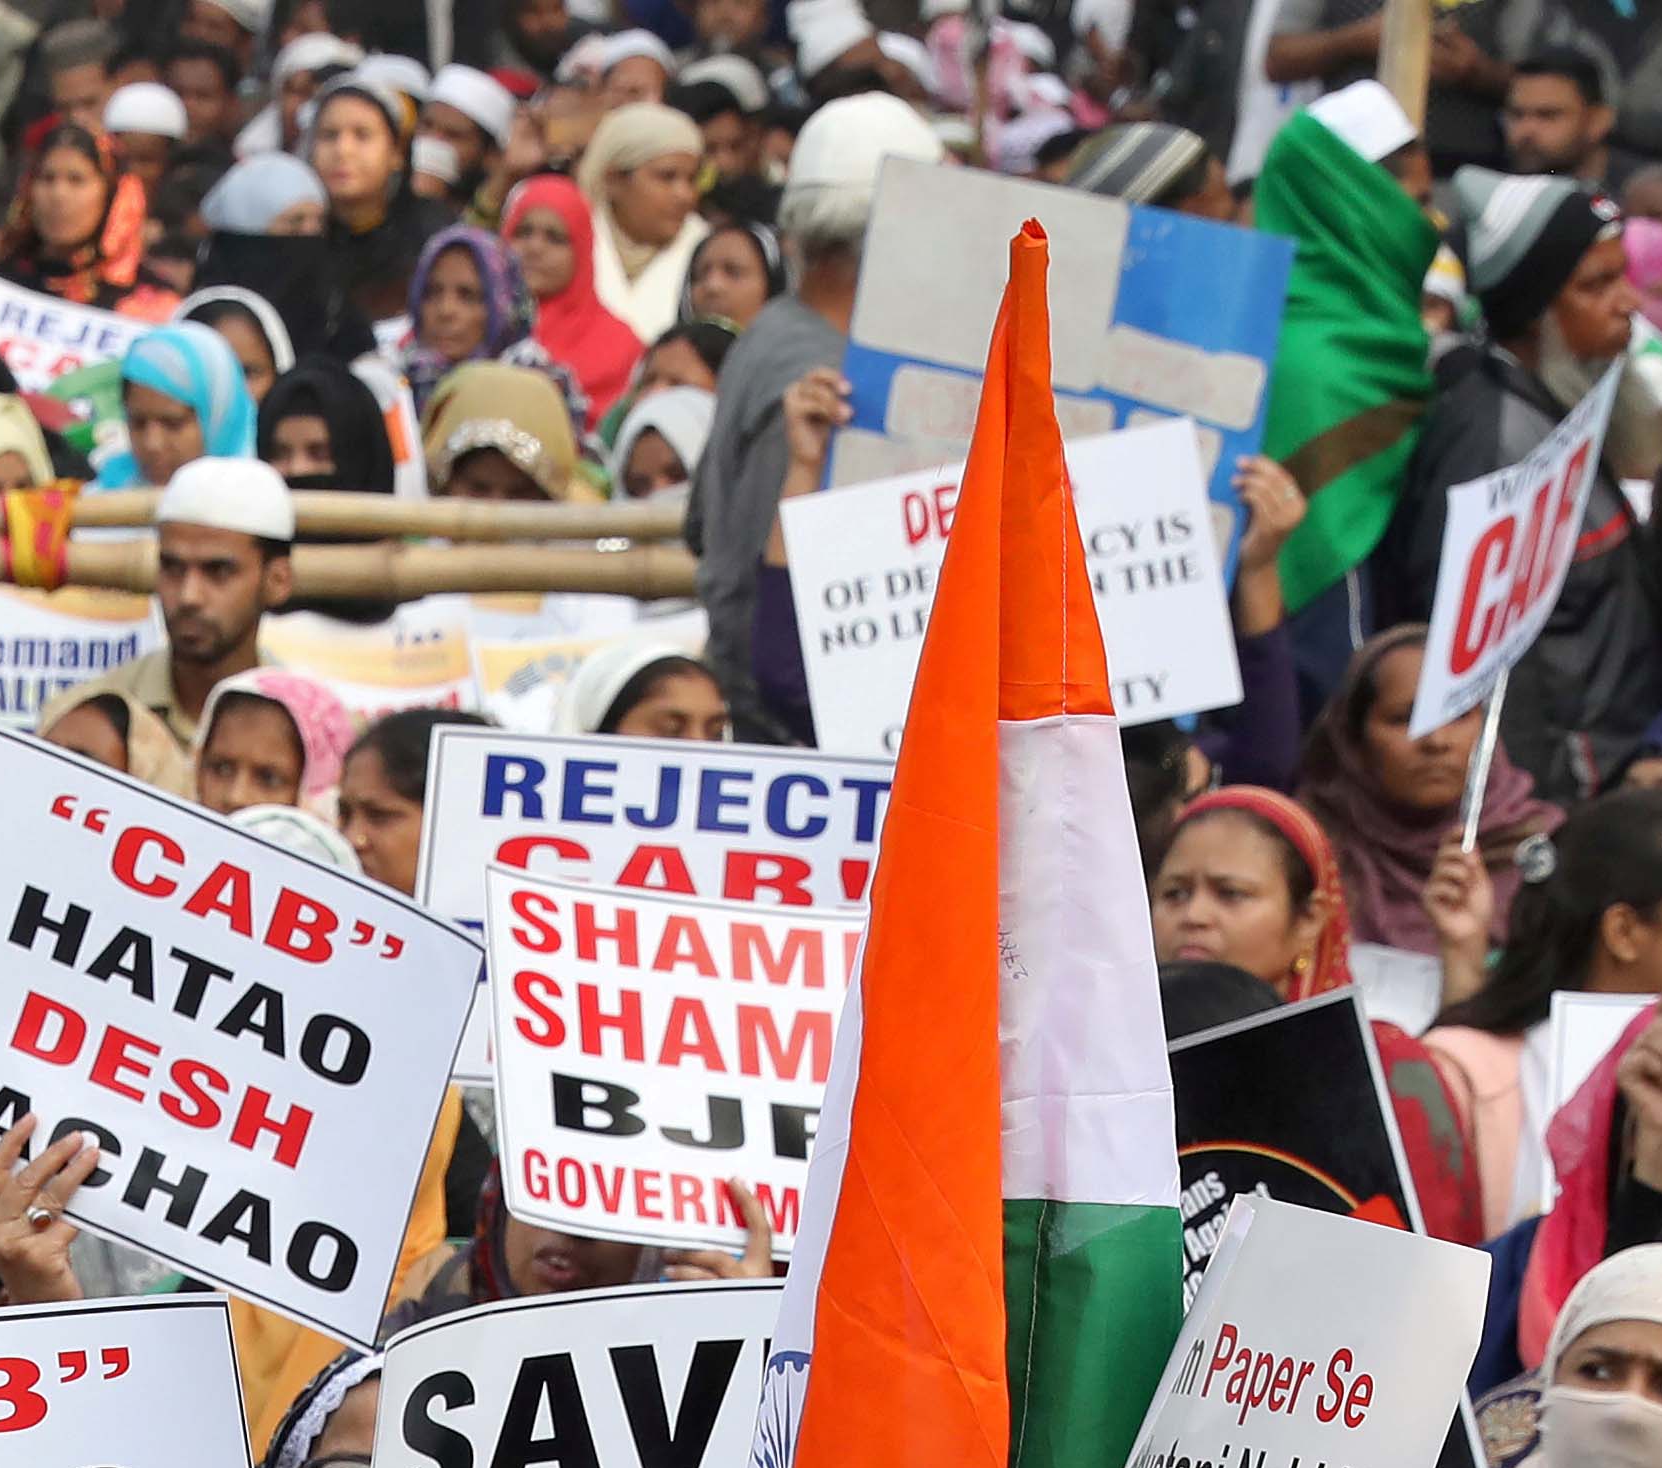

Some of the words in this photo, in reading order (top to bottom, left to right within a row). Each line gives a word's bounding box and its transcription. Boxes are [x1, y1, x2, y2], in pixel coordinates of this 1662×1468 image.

[820, 614, 879, 655] NO
[1124, 553, 1200, 594] THE
[49, 794, 407, 967] “CAB”
[7, 884, 373, 1088] HATAO
[512, 967, 834, 1084] SHAM
[9, 989, 316, 1171] DESH
[1202, 1323, 1317, 1427] Paper
[1315, 1346, 1377, 1430] Se
